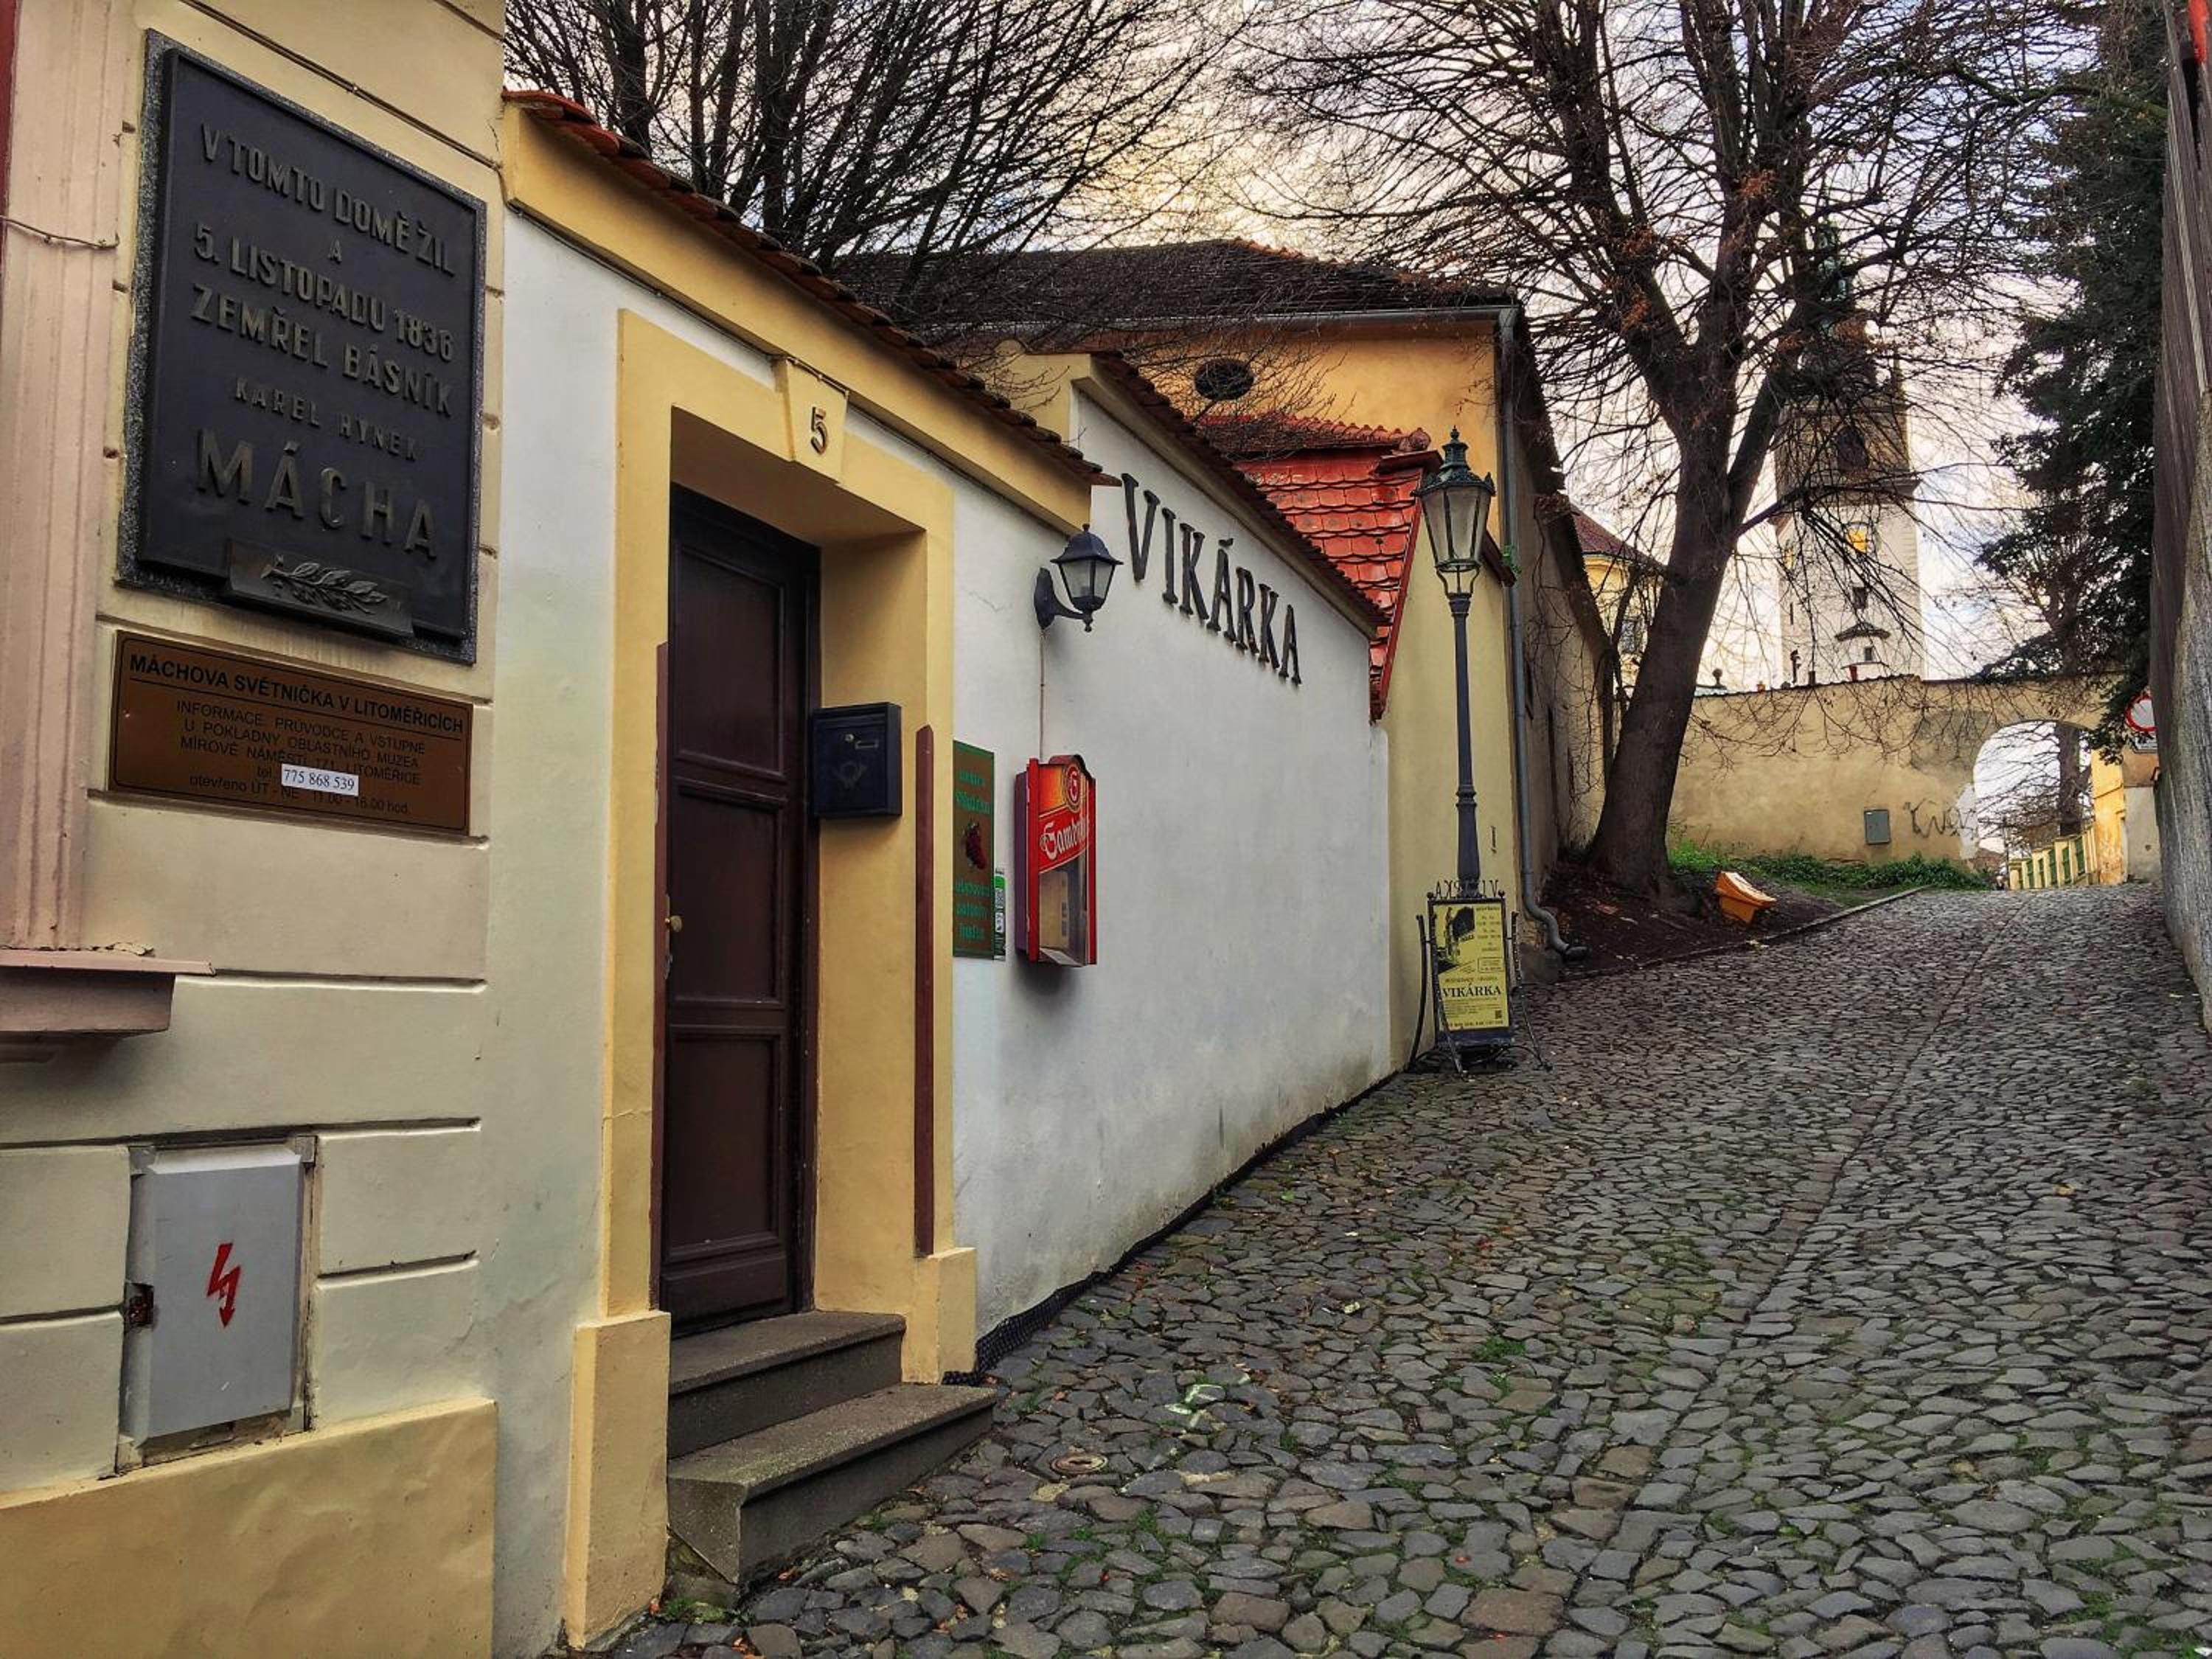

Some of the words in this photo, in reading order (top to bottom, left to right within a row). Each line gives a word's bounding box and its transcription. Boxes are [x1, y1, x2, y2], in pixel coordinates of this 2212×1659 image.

[201, 122, 220, 163] V
[228, 136, 325, 212] TOMTO
[327, 237, 343, 264] A
[189, 282, 329, 369] ZEMŘEL
[193, 223, 220, 264] 5.
[229, 236, 386, 332] LISTOPADU
[393, 305, 454, 364] 1836
[234, 376, 321, 429] KAREL
[338, 413, 417, 462] HYNEK
[810, 406, 828, 456] 5
[196, 428, 437, 560] MÁCHA
[1121, 473, 1301, 685] VIKÁRKA
[129, 653, 229, 689] MÁCHOVA
[234, 674, 334, 709] SVĚTNIČKA
[339, 695, 350, 711] V
[354, 700, 464, 733] LITOMĚŘICÍCH
[184, 718, 195, 732] U
[203, 721, 281, 745] POKLADNY
[284, 769, 305, 783] 775
[309, 772, 330, 788] 868
[333, 776, 355, 791] 539
[1441, 981, 1501, 998] VIKÁRKA
